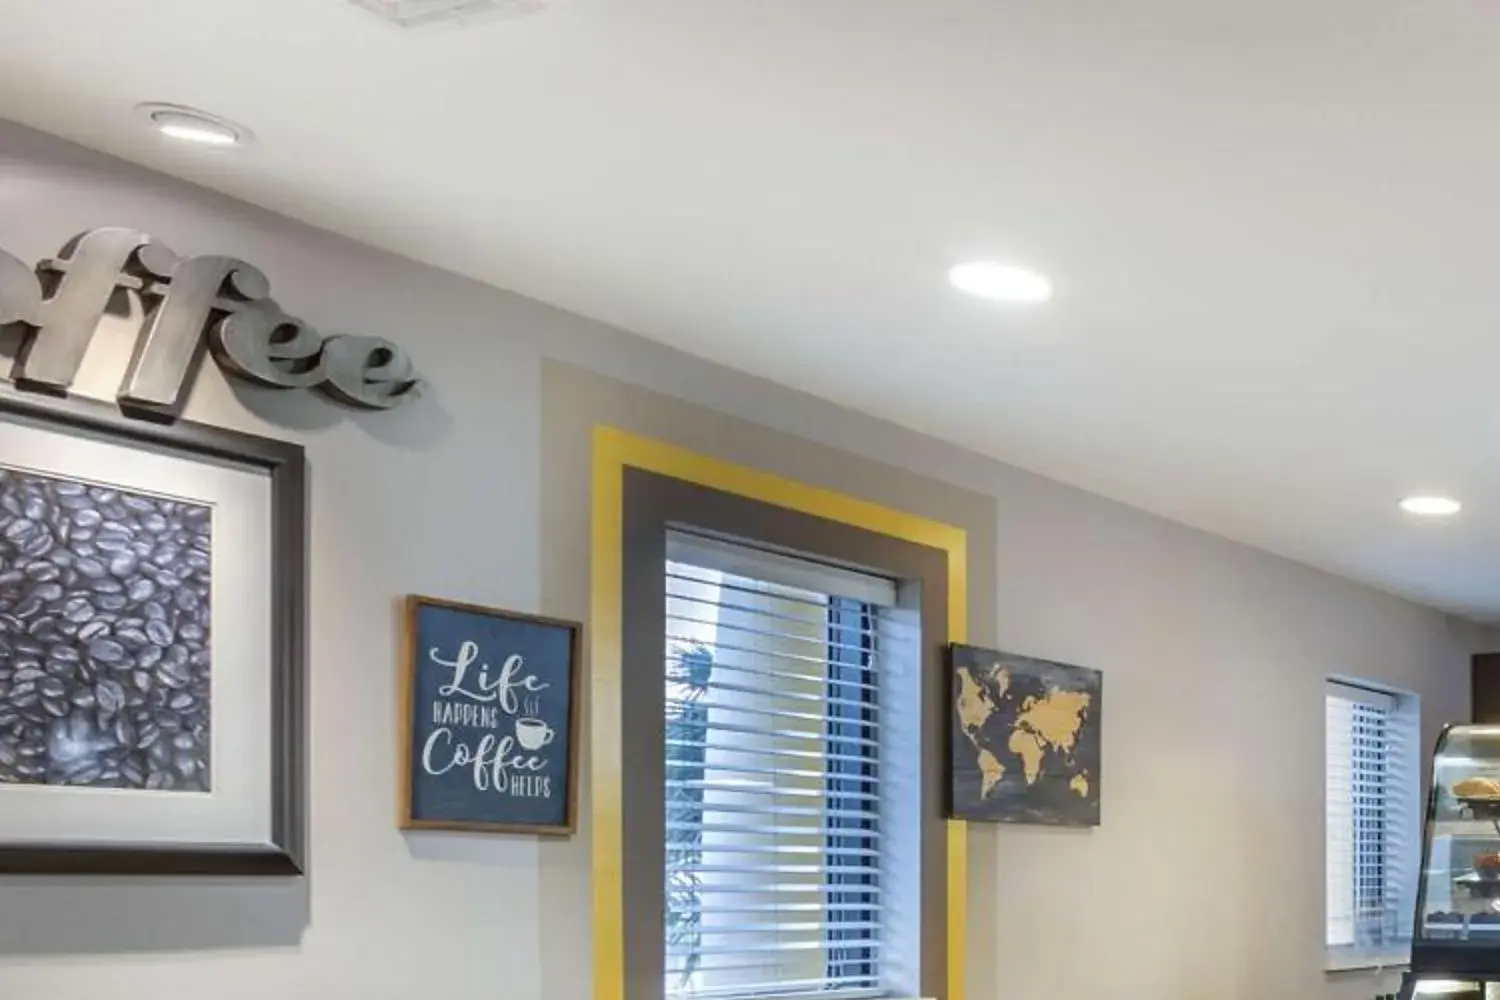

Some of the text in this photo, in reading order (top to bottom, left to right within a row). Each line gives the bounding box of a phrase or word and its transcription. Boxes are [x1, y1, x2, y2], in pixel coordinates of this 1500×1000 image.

[429, 640, 550, 714] Life
[432, 700, 500, 729] HAPPENS
[422, 727, 548, 792] Coffee
[511, 774, 551, 799] HELPS
